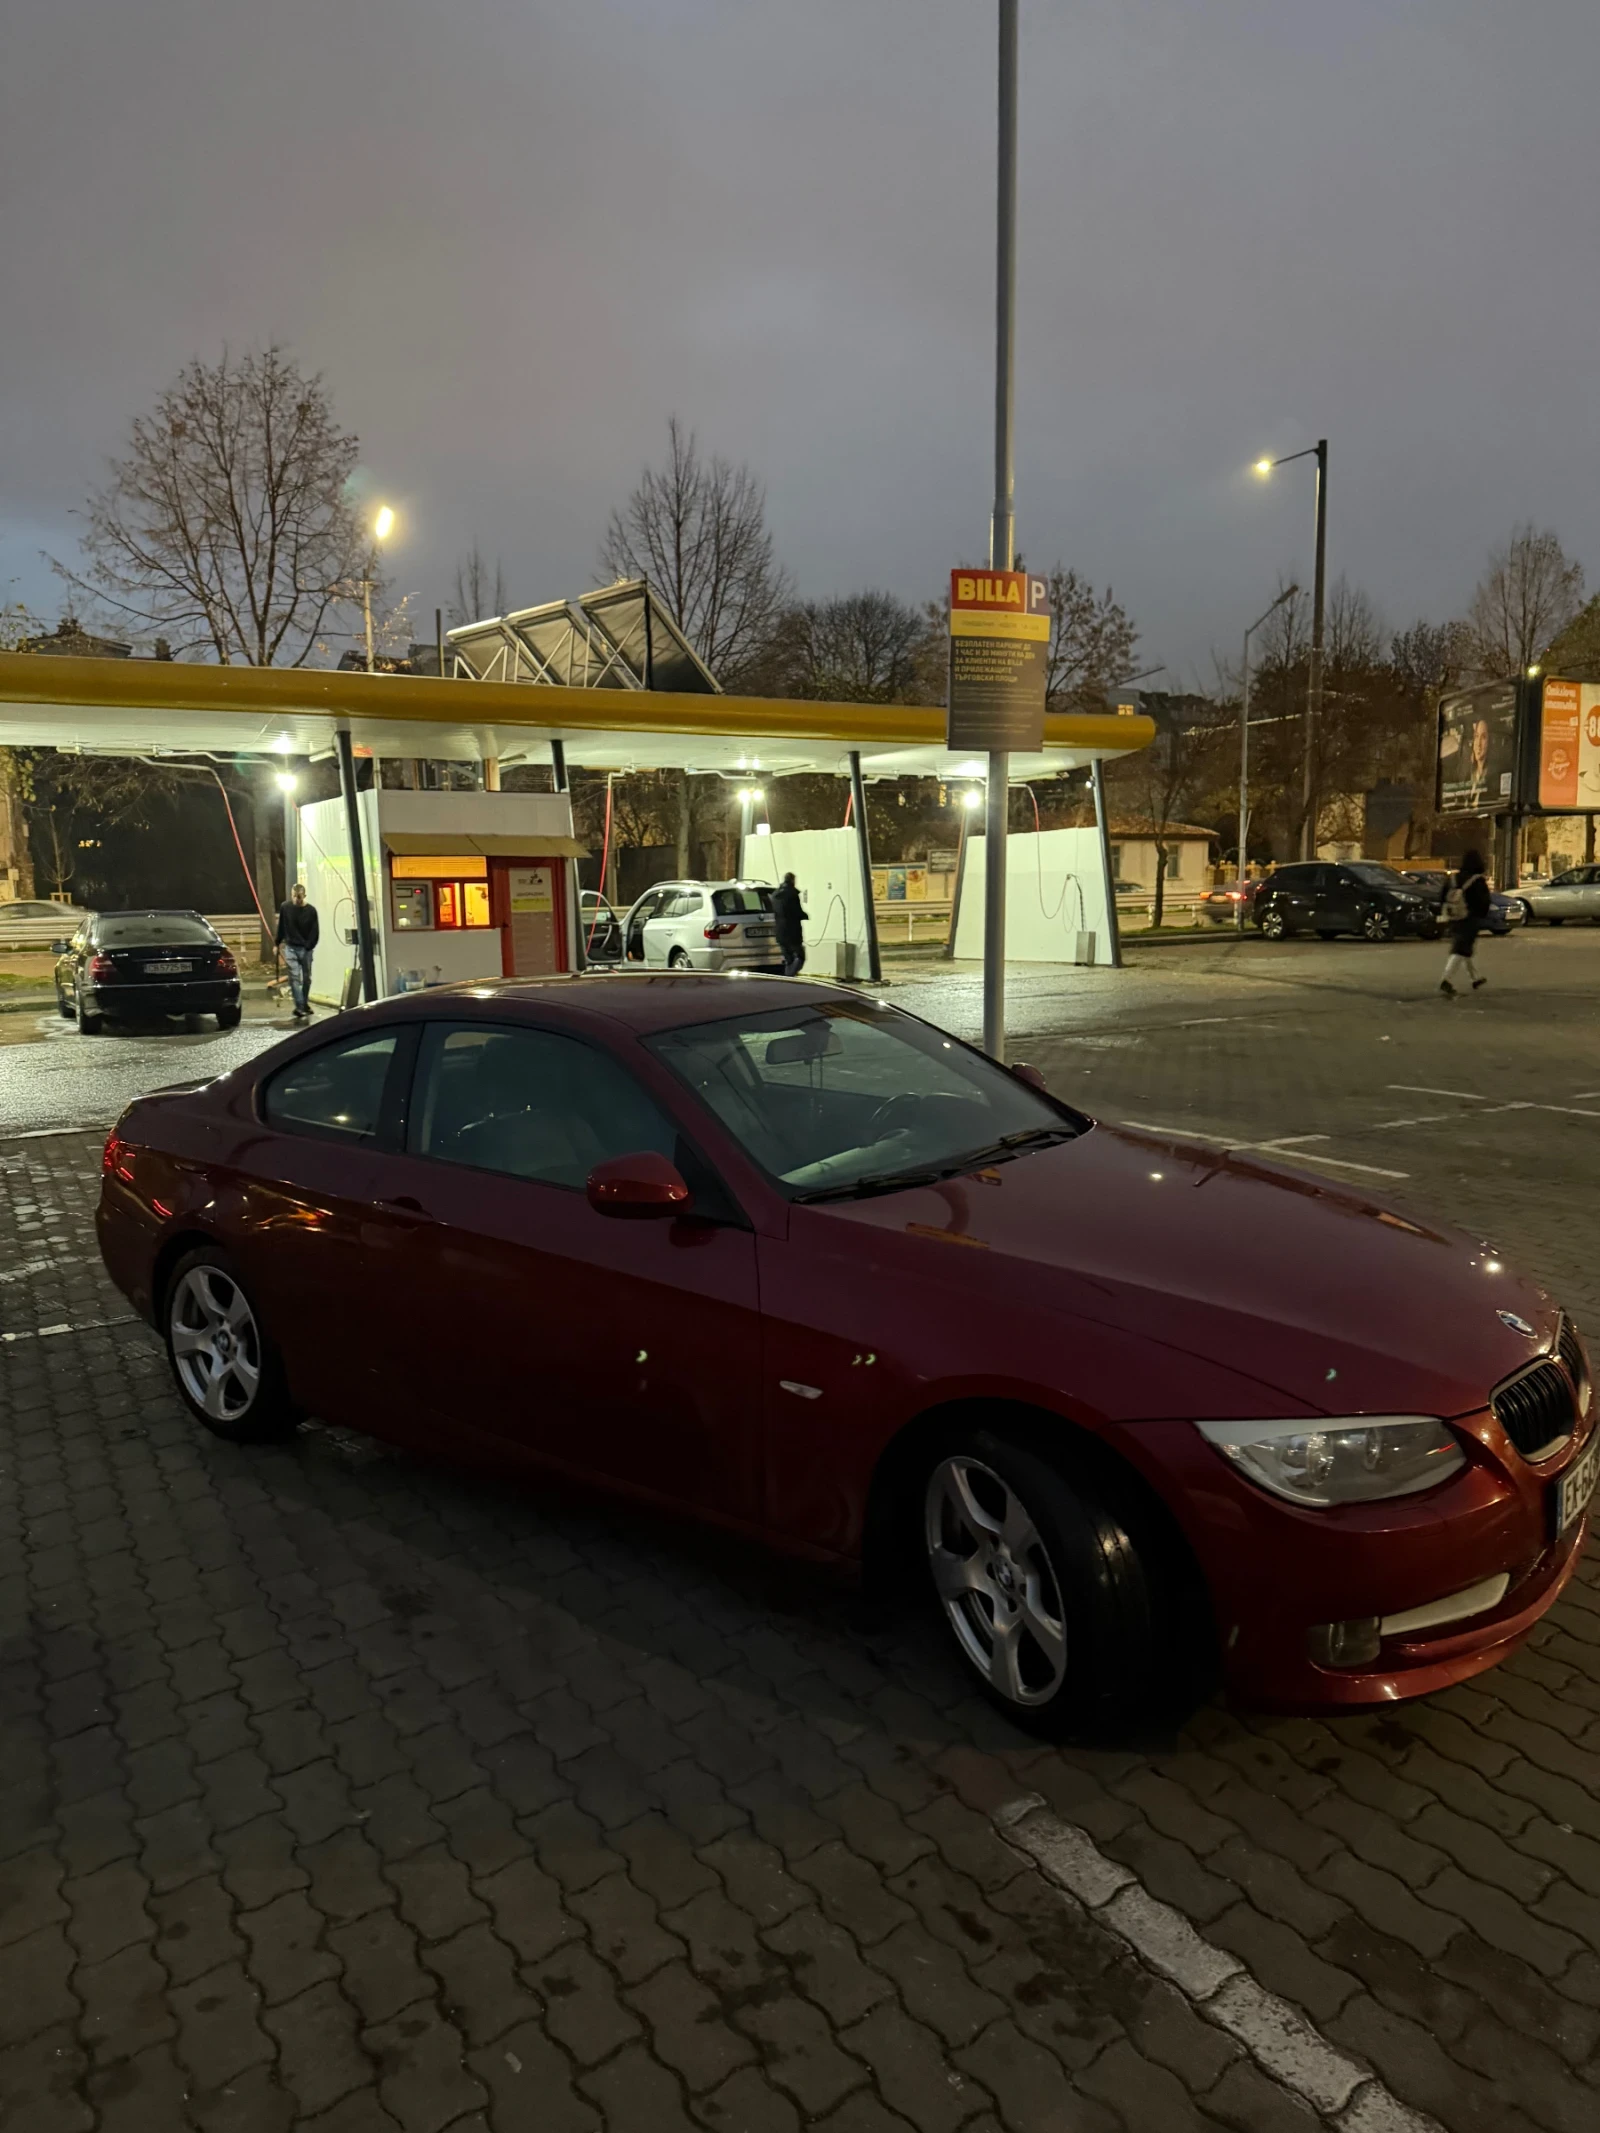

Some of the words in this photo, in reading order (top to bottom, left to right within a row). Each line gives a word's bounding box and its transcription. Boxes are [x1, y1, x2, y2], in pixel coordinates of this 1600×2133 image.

[958, 578, 1020, 604] BILLA
[1031, 580, 1046, 608] P
[955, 640, 995, 648] БЕЗПЛАТЕН
[996, 641, 1022, 649] ПАРКИНГ
[961, 666, 1012, 674] ПРИЛЕЖАЩИТЕ
